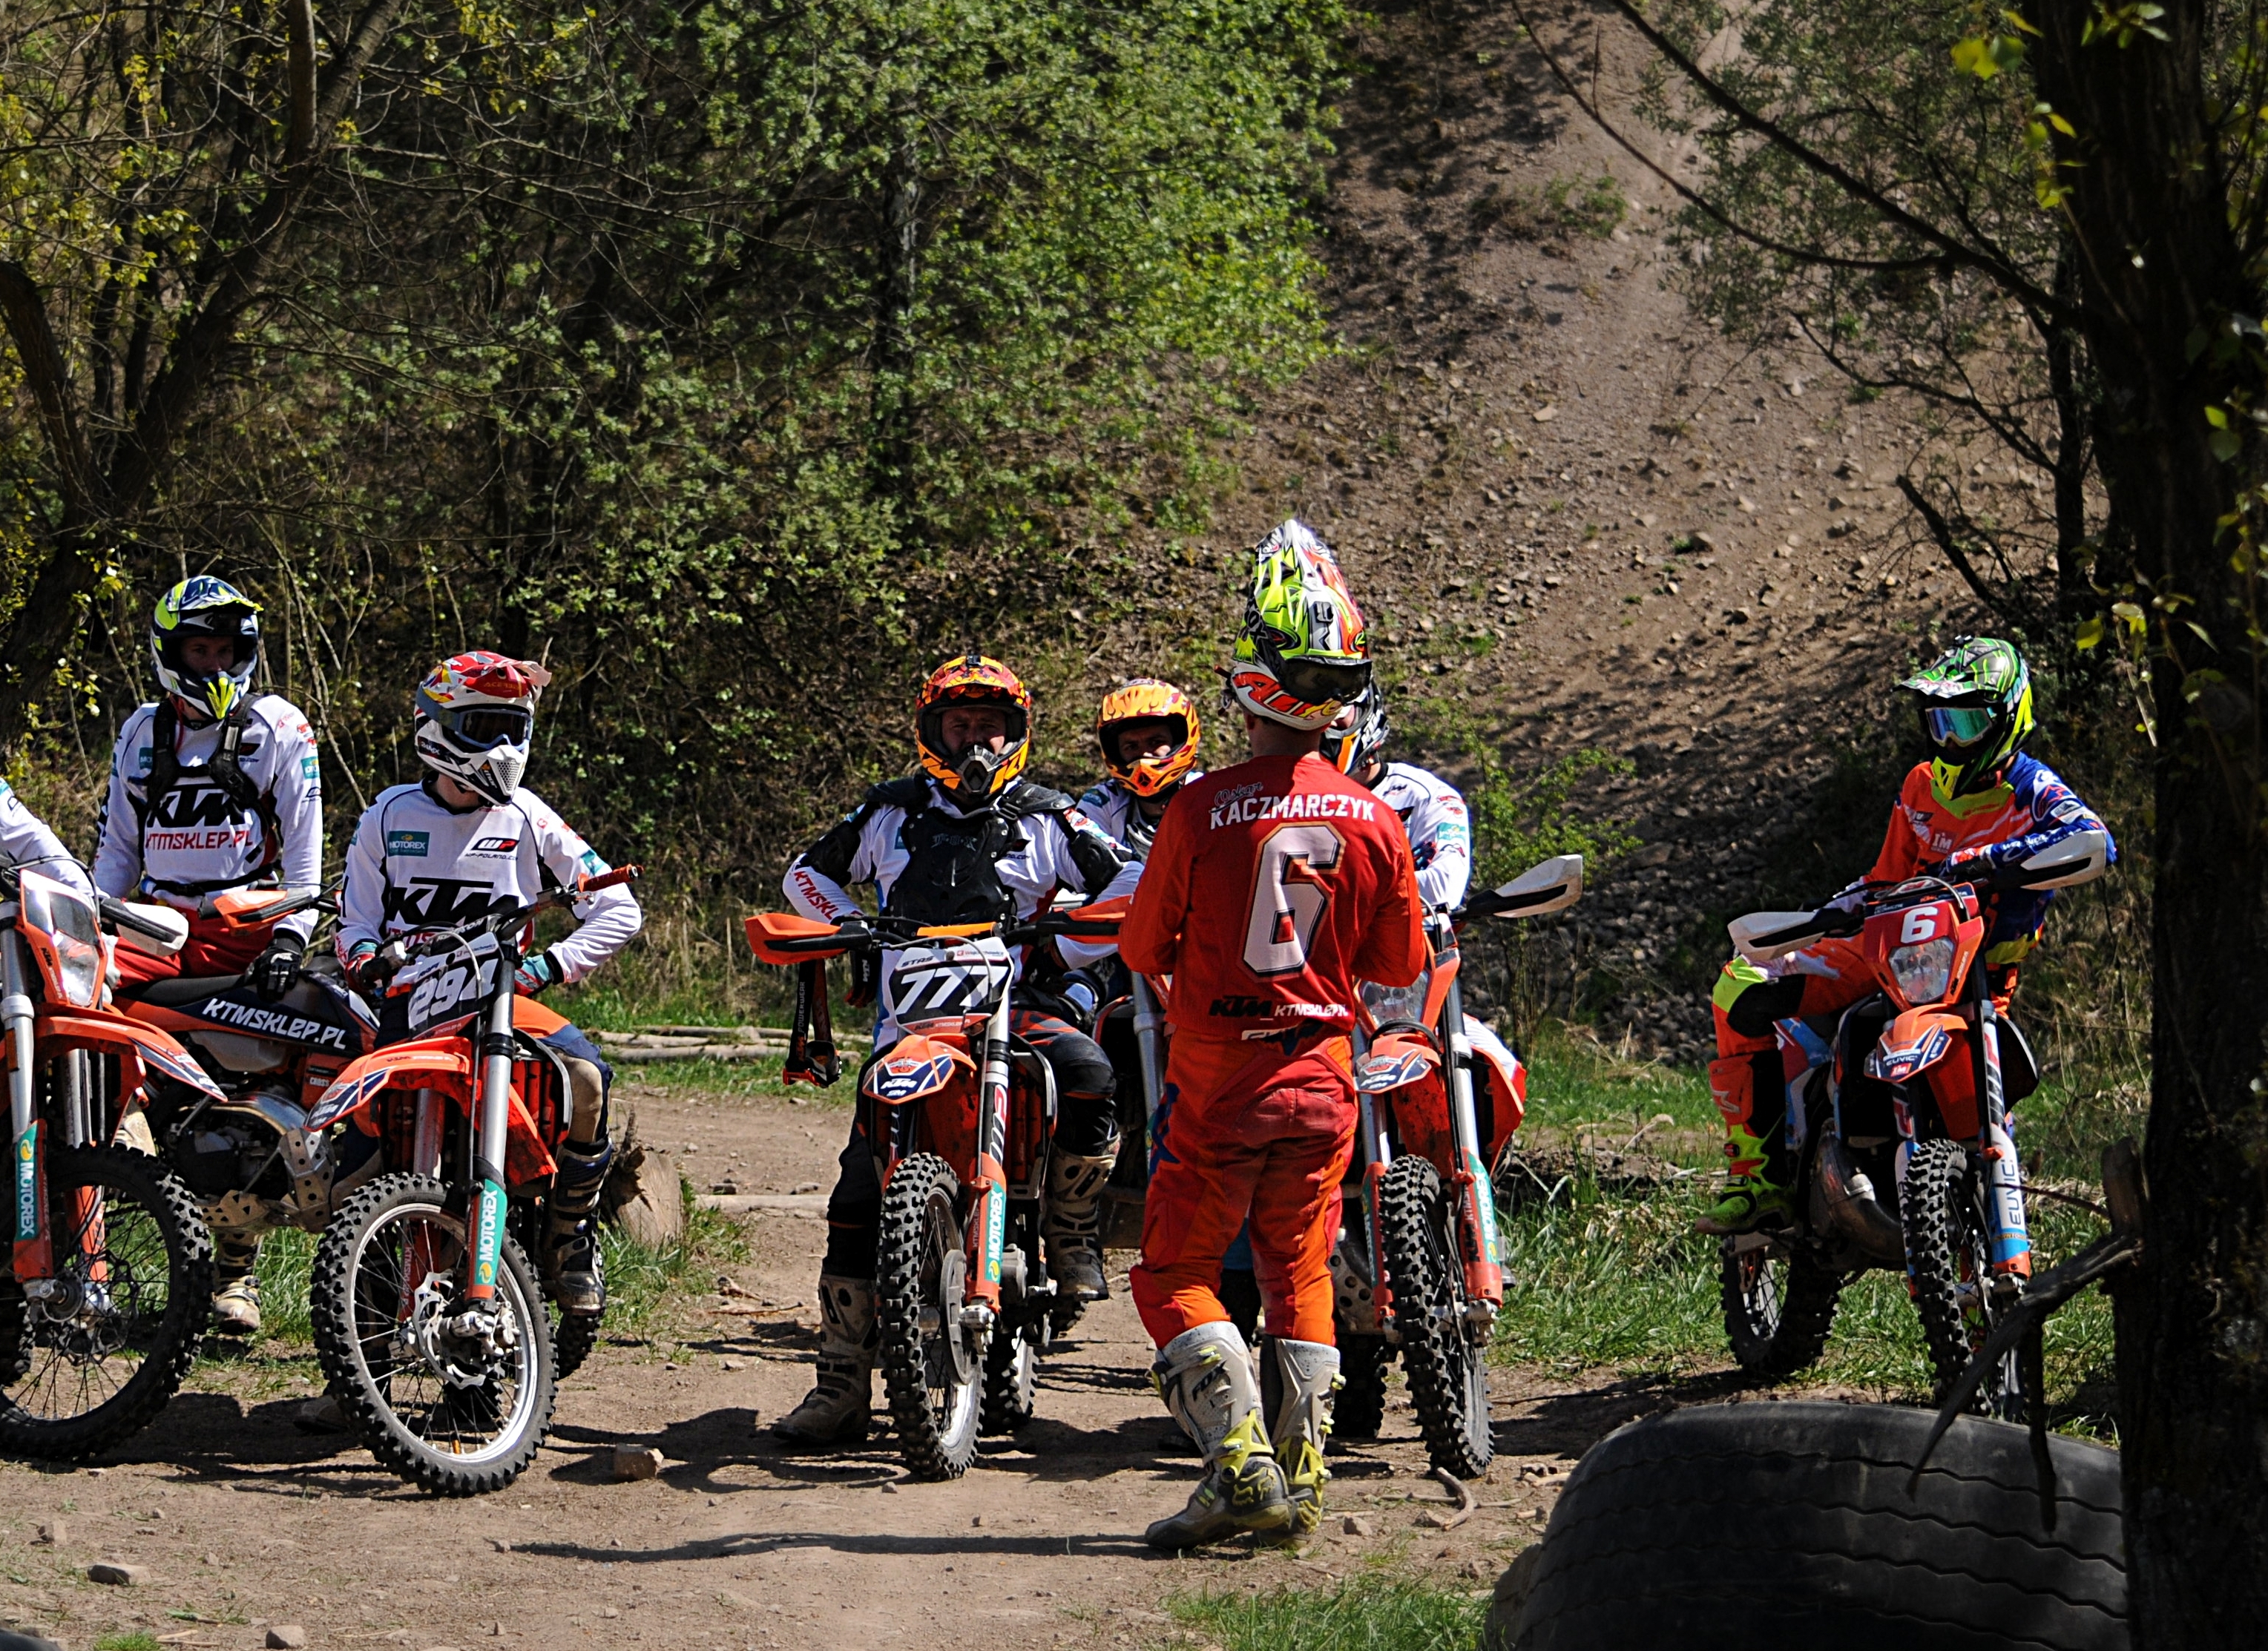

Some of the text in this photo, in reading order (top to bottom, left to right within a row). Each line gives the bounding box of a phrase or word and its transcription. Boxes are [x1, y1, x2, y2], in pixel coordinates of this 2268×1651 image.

[147, 784, 246, 828] KTM
[1210, 794, 1375, 830] KACZMARCZYK
[386, 877, 519, 926] KTM
[1243, 825, 1341, 975] 6
[1901, 906, 1938, 943] 6
[901, 955, 934, 967] STAS
[409, 958, 499, 1029] 294
[895, 965, 1009, 1015] 777
[1209, 995, 1273, 1018] KTM
[202, 998, 346, 1049] KTMSKLEP.PL
[881, 1078, 917, 1089] KTM
[1886, 1055, 1916, 1066] EUVIC
[20, 1161, 35, 1237] MOTOREX
[1474, 1172, 1496, 1242] MOTOREX
[2002, 1161, 2022, 1225] EUVIC
[479, 1190, 498, 1262] MOTOREX
[988, 1190, 1003, 1261] MOTOREX
[1191, 1360, 1226, 1402] FOX
